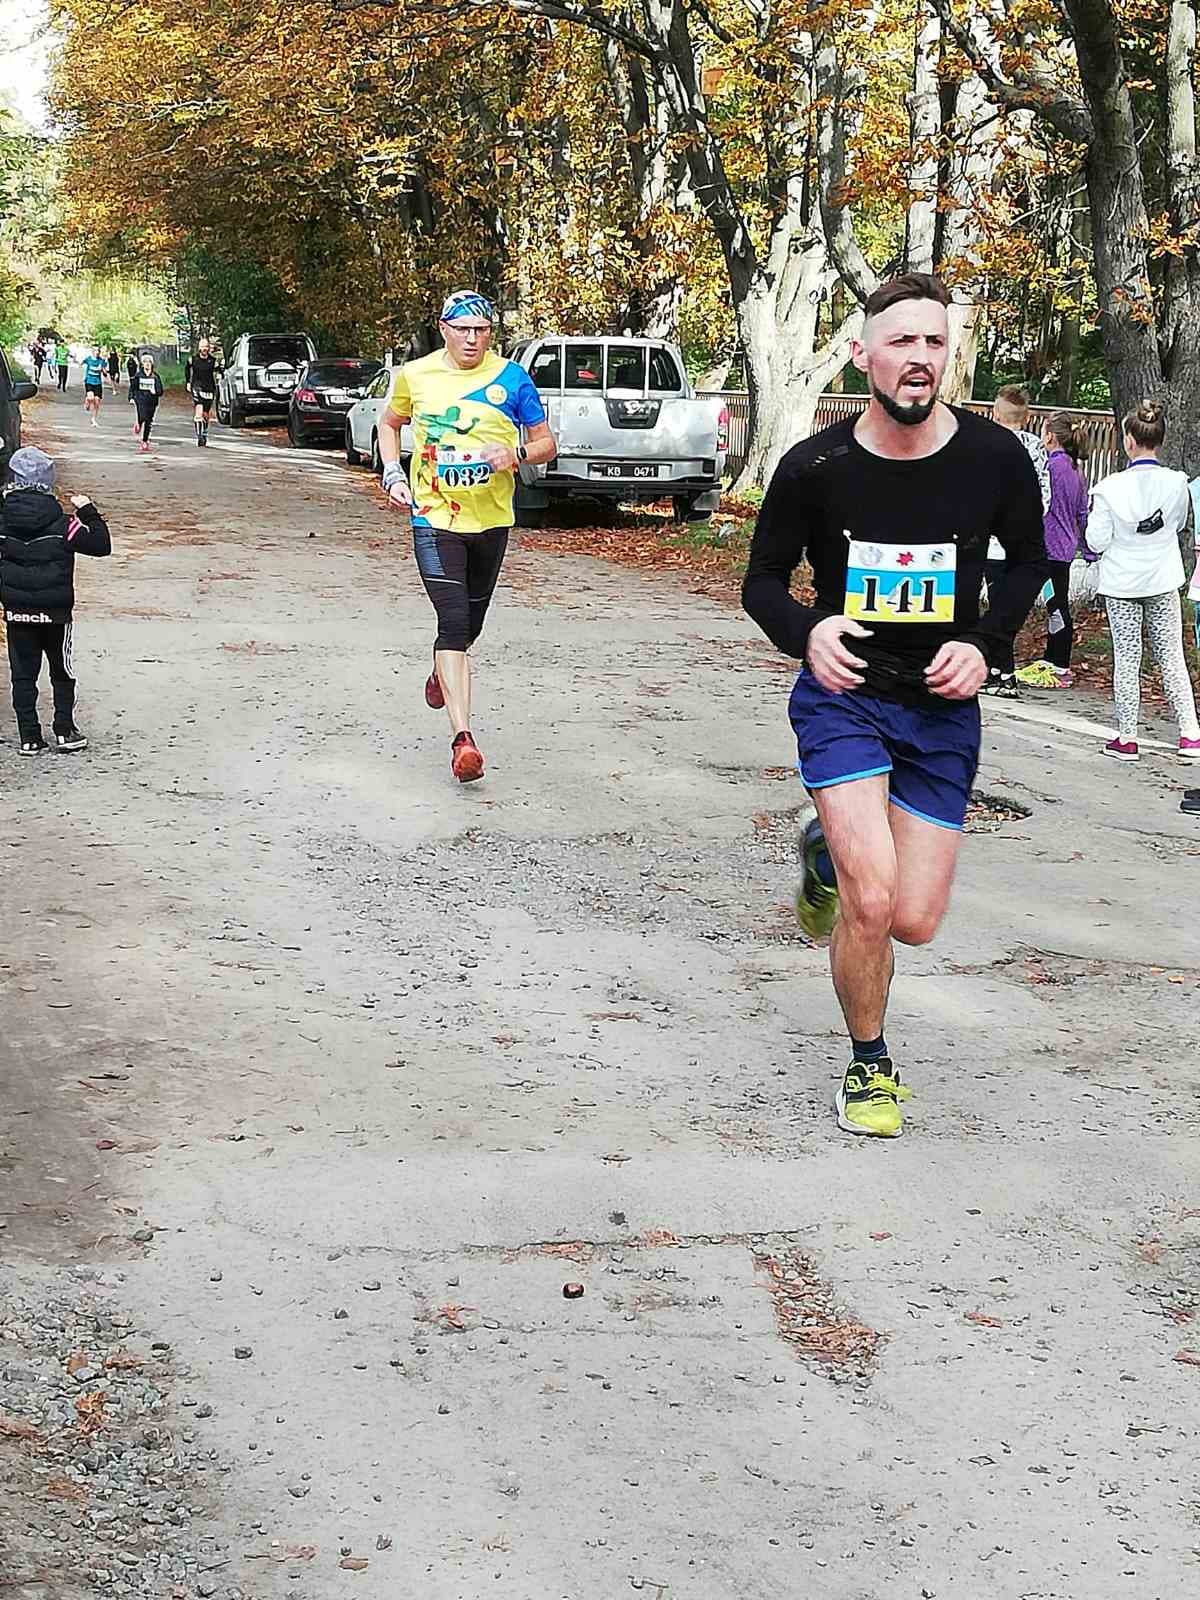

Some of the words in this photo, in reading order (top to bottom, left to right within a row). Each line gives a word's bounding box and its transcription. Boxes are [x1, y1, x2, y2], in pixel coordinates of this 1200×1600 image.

[444, 467, 490, 487] 032
[862, 577, 936, 613] 141
[6, 610, 53, 623] Bench.
